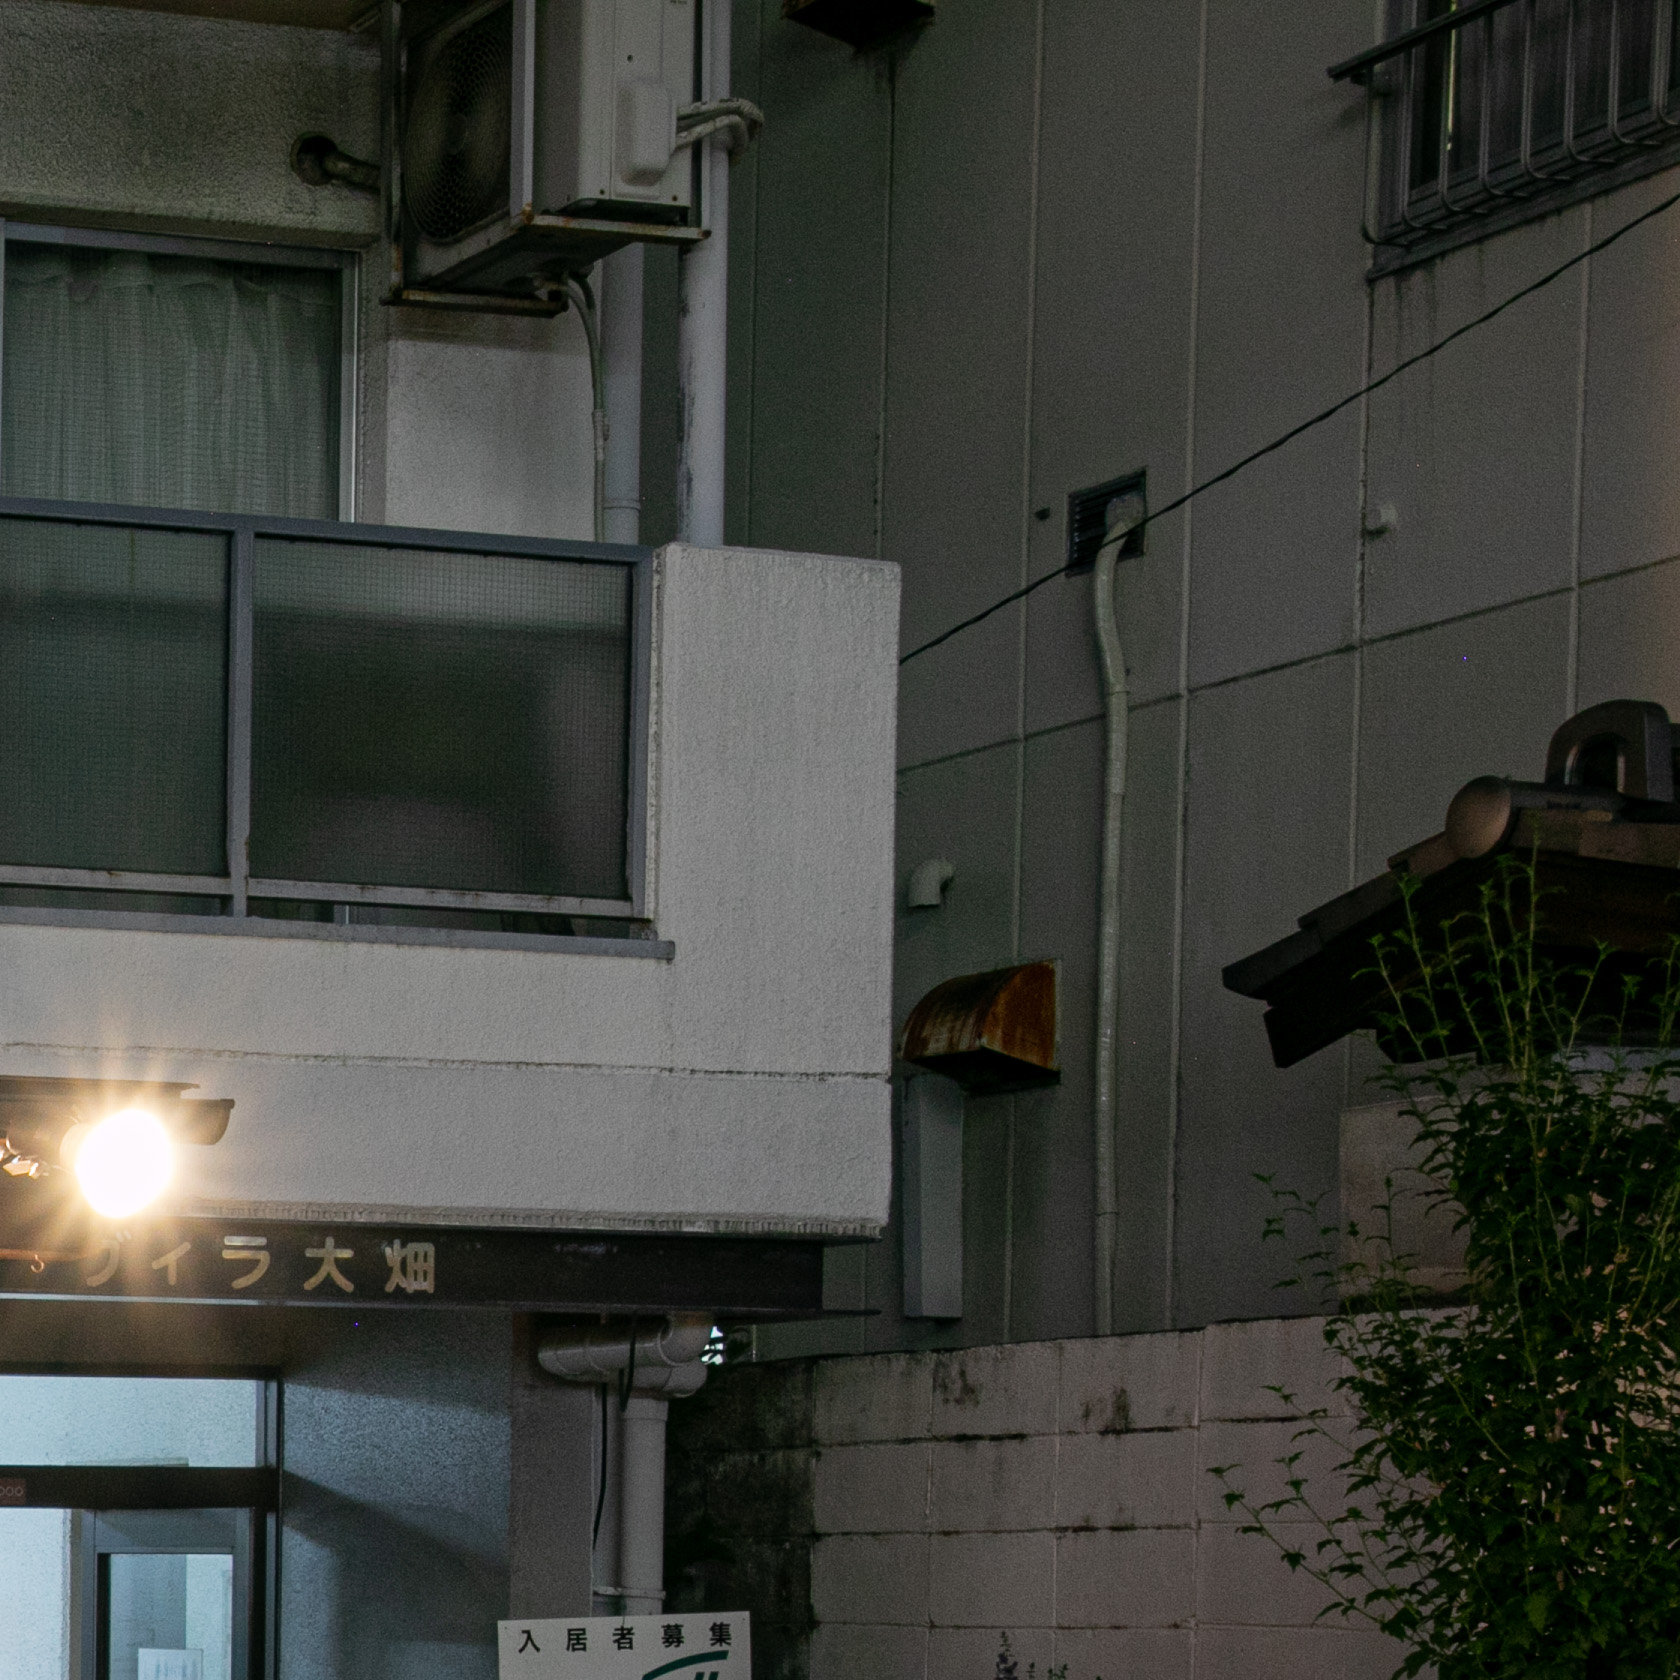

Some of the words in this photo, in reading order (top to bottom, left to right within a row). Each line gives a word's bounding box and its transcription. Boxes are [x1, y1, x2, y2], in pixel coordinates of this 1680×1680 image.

[518, 1622, 733, 1654] 入居者募集
